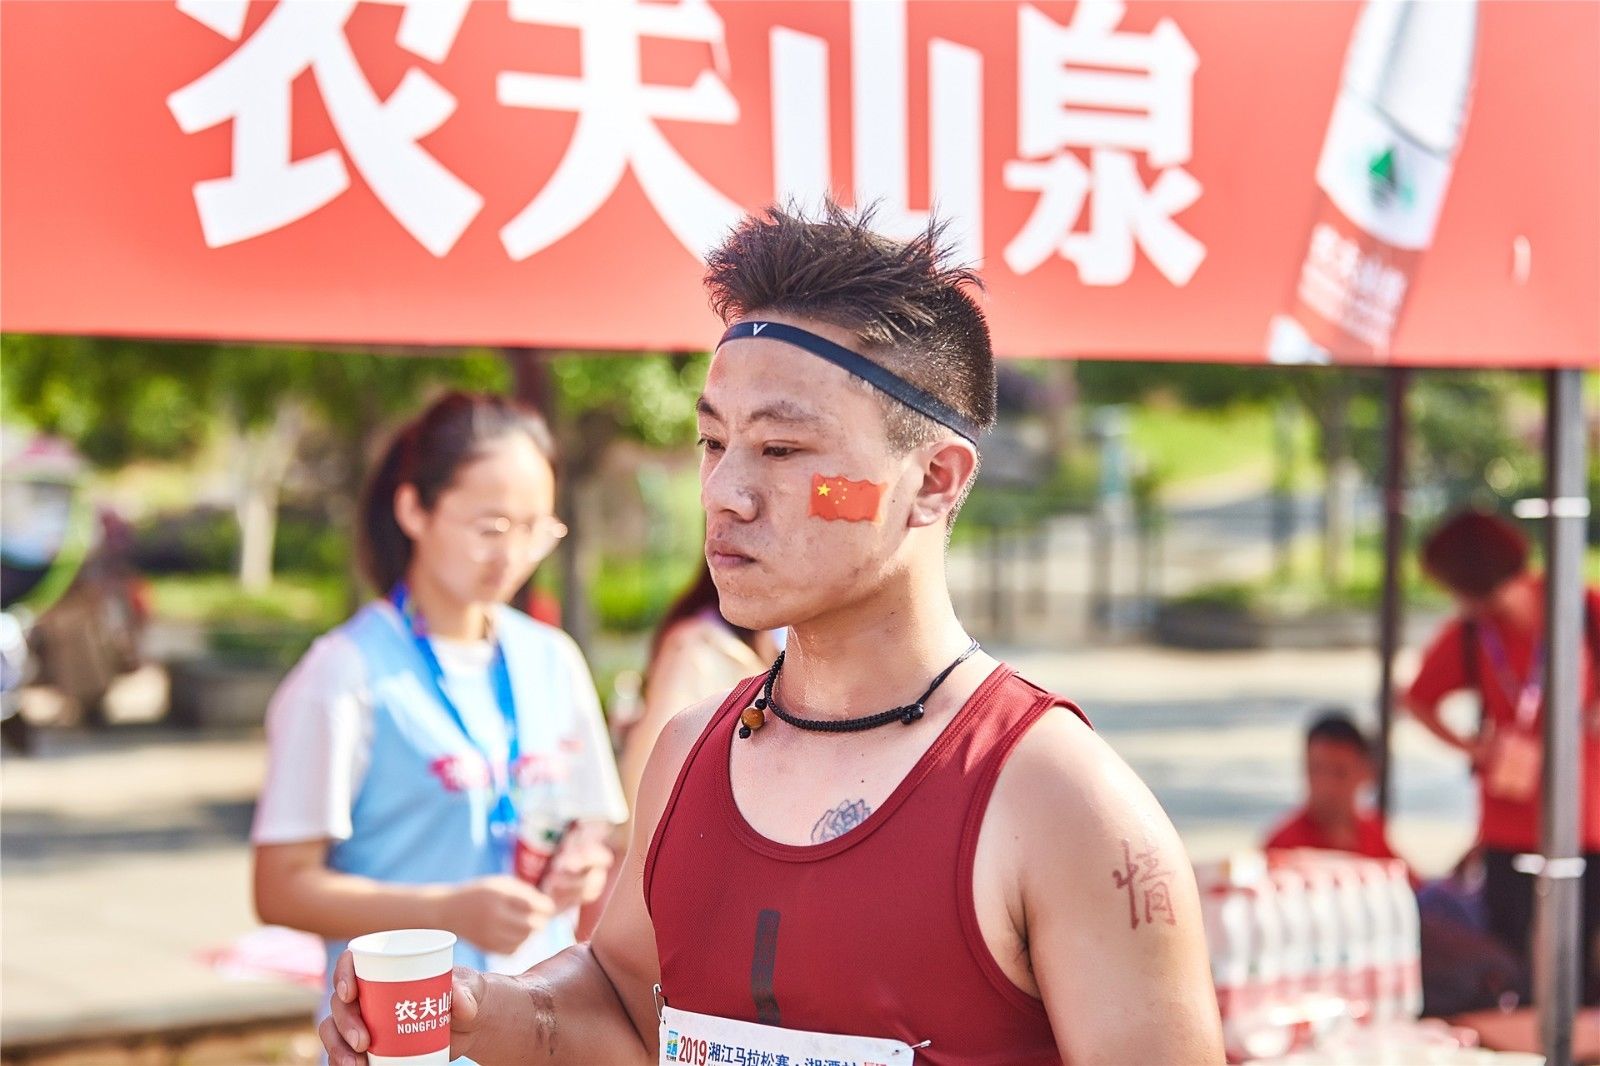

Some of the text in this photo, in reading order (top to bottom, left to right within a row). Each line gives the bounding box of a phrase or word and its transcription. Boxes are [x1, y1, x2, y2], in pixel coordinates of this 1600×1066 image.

[166, 0, 1206, 285] 农夫山泉
[1112, 839, 1176, 930] 情
[395, 990, 452, 1021] 农夫山
[397, 1013, 449, 1034] NONGFU SP
[680, 1035, 707, 1066] 2019
